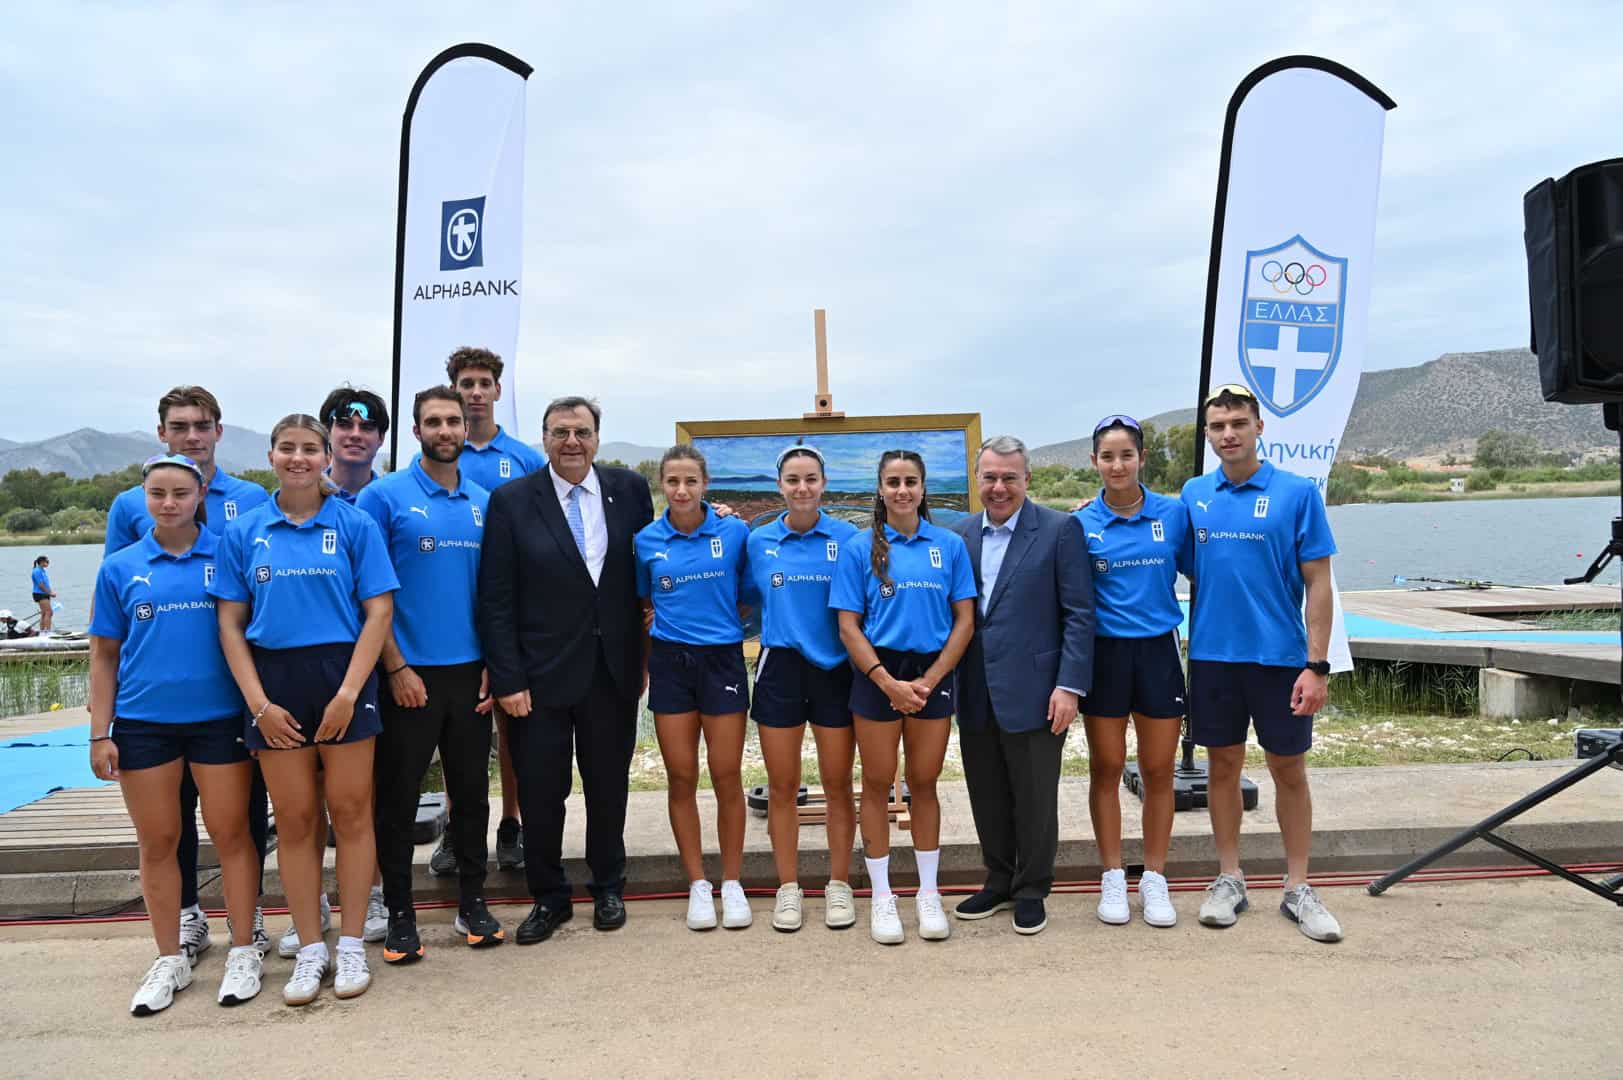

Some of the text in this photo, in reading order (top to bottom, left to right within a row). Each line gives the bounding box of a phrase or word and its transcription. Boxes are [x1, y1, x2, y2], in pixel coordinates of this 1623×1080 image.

[1255, 302, 1329, 322] ΕΛΛΑΣ
[1256, 437, 1335, 465] ληνική
[1210, 531, 1265, 542] ALPHA BANK
[438, 540, 463, 548] ALPHA
[1112, 558, 1165, 568] ALPHA BANK
[275, 567, 337, 577] ALPHA BANK
[676, 570, 725, 583] ALPHA BANK
[897, 581, 923, 589] ALPHA
[157, 602, 190, 612] ALPHA
